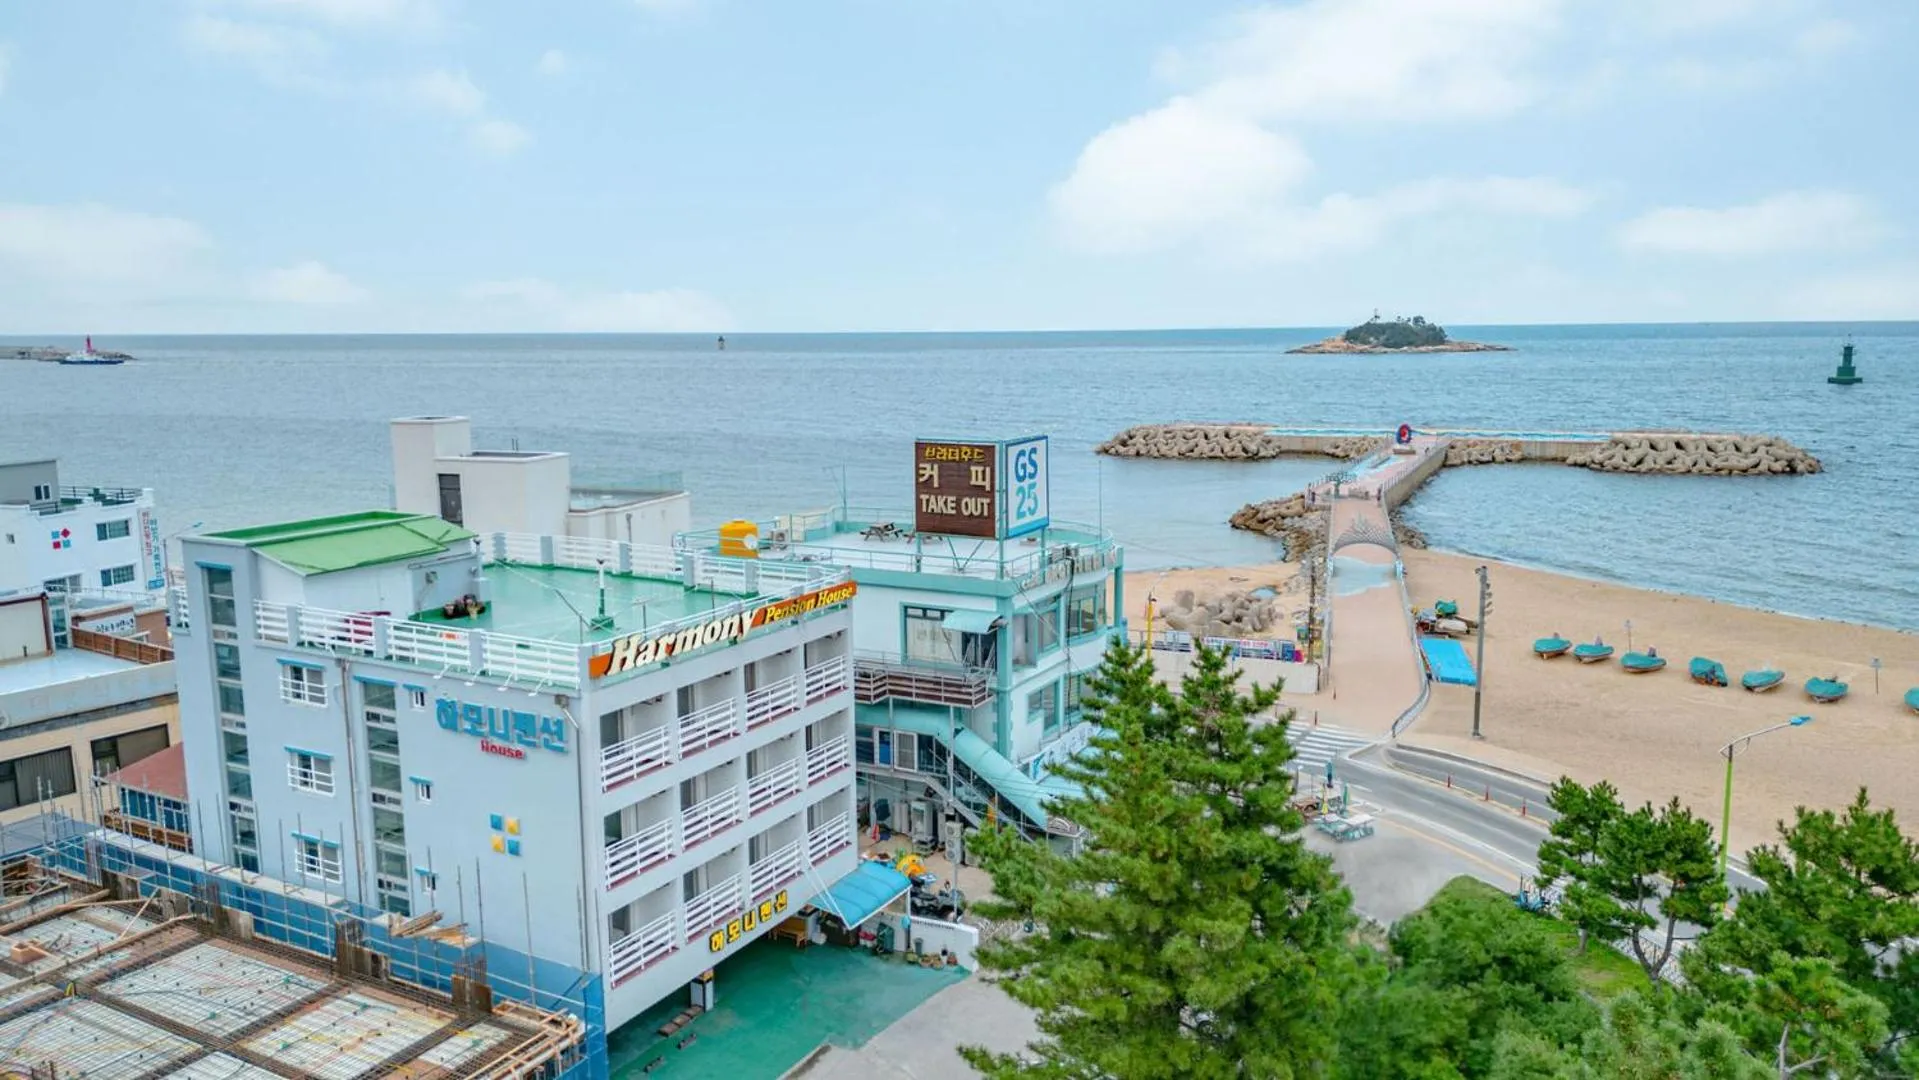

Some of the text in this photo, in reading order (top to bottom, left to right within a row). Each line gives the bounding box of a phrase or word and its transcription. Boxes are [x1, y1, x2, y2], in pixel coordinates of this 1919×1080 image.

[1015, 447, 1038, 482] GS
[920, 494, 990, 516] TAKE OUT
[1015, 482, 1039, 520] 25
[606, 586, 854, 676] Harmony Pension House
[435, 697, 567, 754] 하모니펜션
[481, 739, 525, 760] House
[709, 889, 788, 953] 하모니펜션
